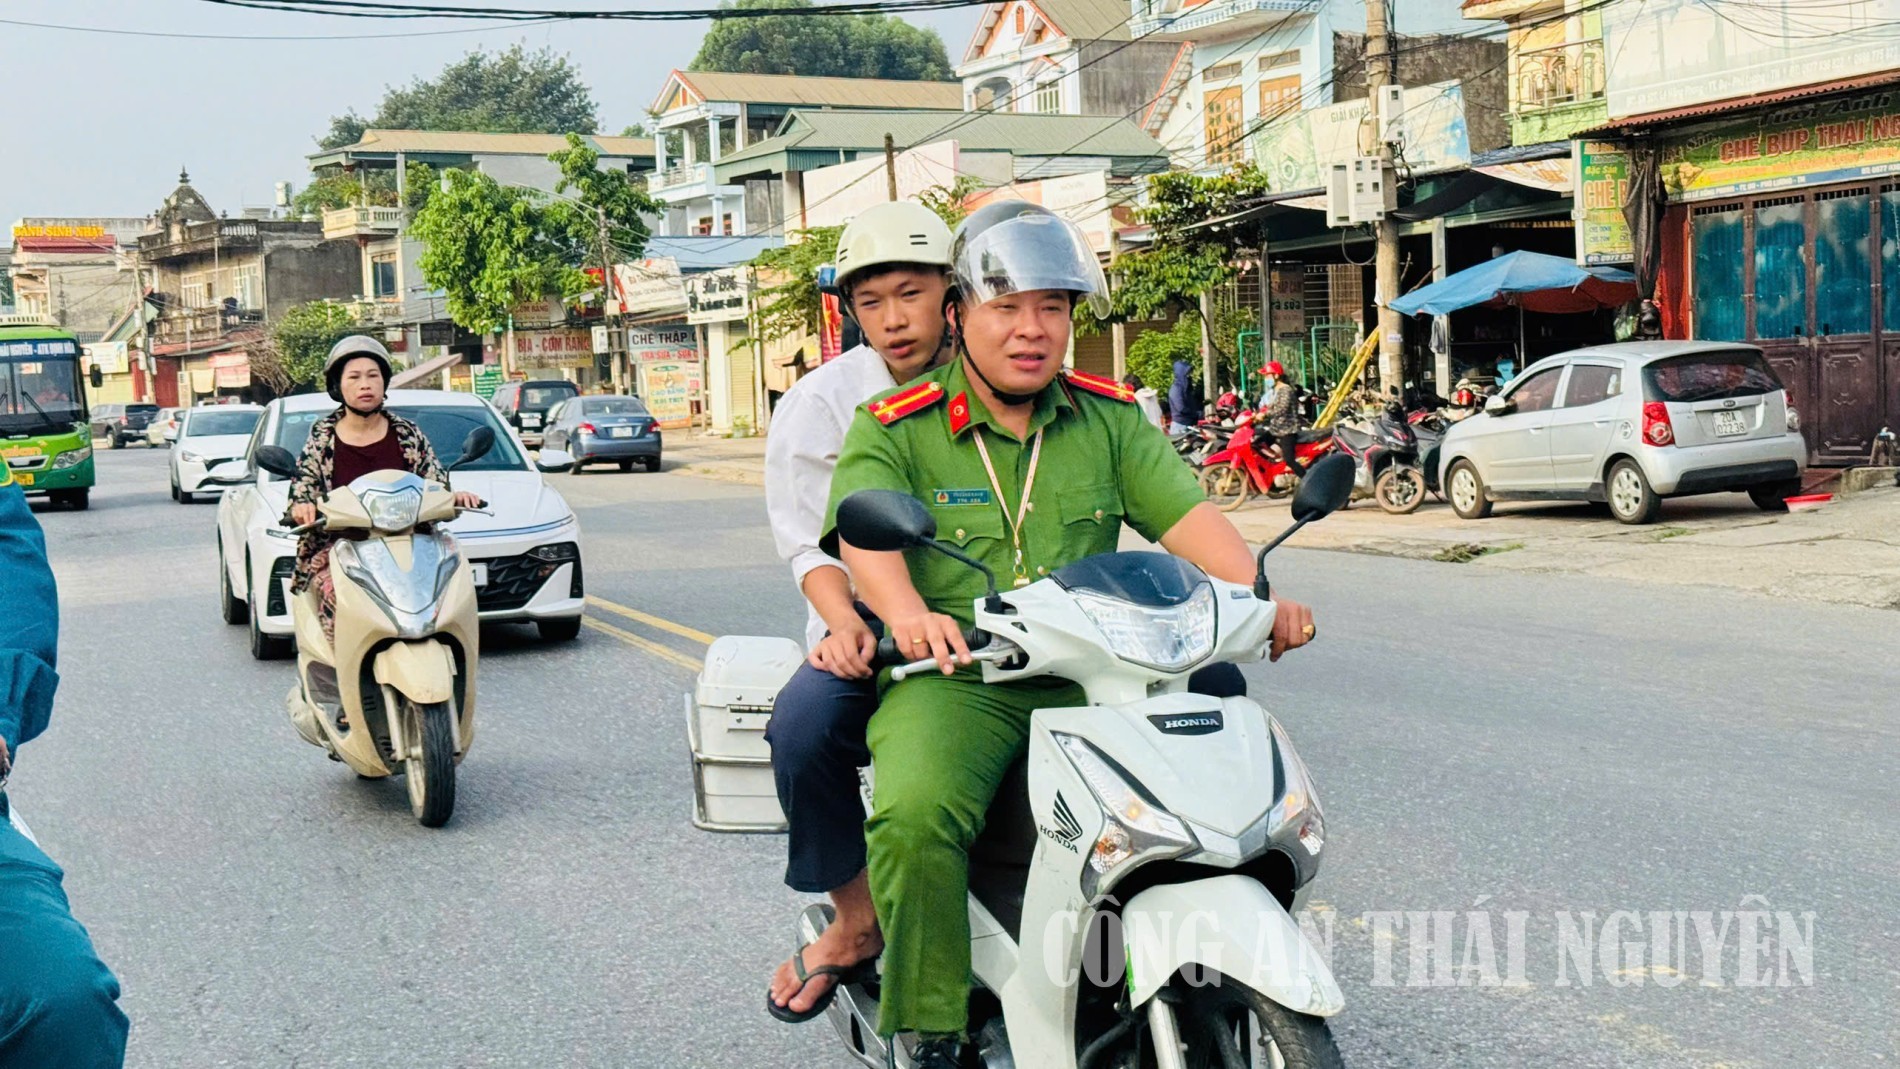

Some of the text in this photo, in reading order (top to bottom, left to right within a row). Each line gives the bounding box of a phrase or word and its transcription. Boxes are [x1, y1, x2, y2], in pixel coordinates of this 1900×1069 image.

[45, 225, 73, 237] SINH
[1164, 717, 1220, 730] HONDA
[1039, 823, 1079, 855] HONDA
